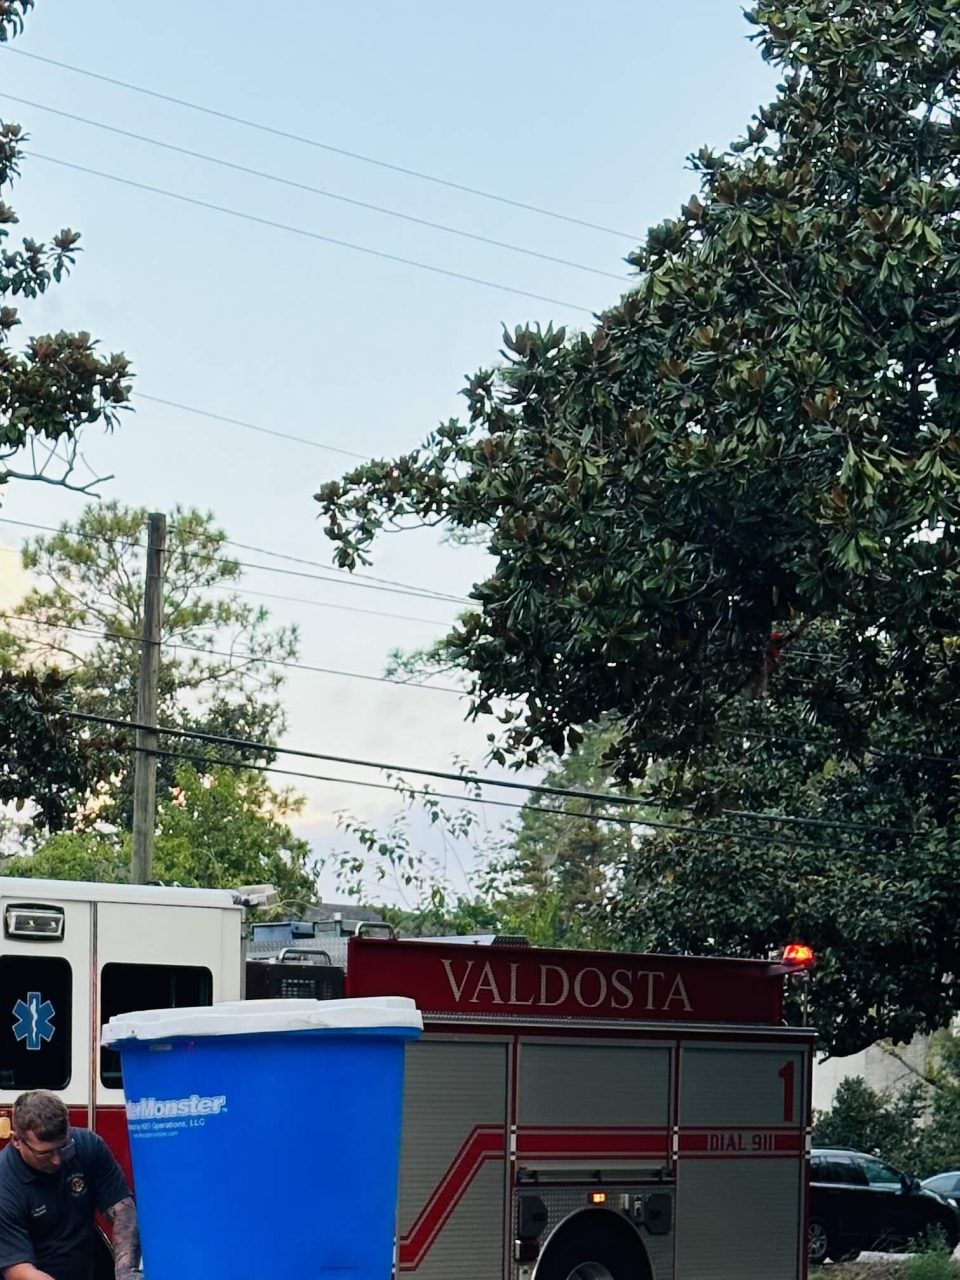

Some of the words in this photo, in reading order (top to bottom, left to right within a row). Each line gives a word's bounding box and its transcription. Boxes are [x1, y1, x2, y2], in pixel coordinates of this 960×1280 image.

[440, 958, 695, 1012] VALDOSTA
[778, 1060, 795, 1122] 1
[189, 1117, 206, 1127] LLC
[710, 1133, 746, 1152] DIAL
[751, 1133, 775, 1152] 911
